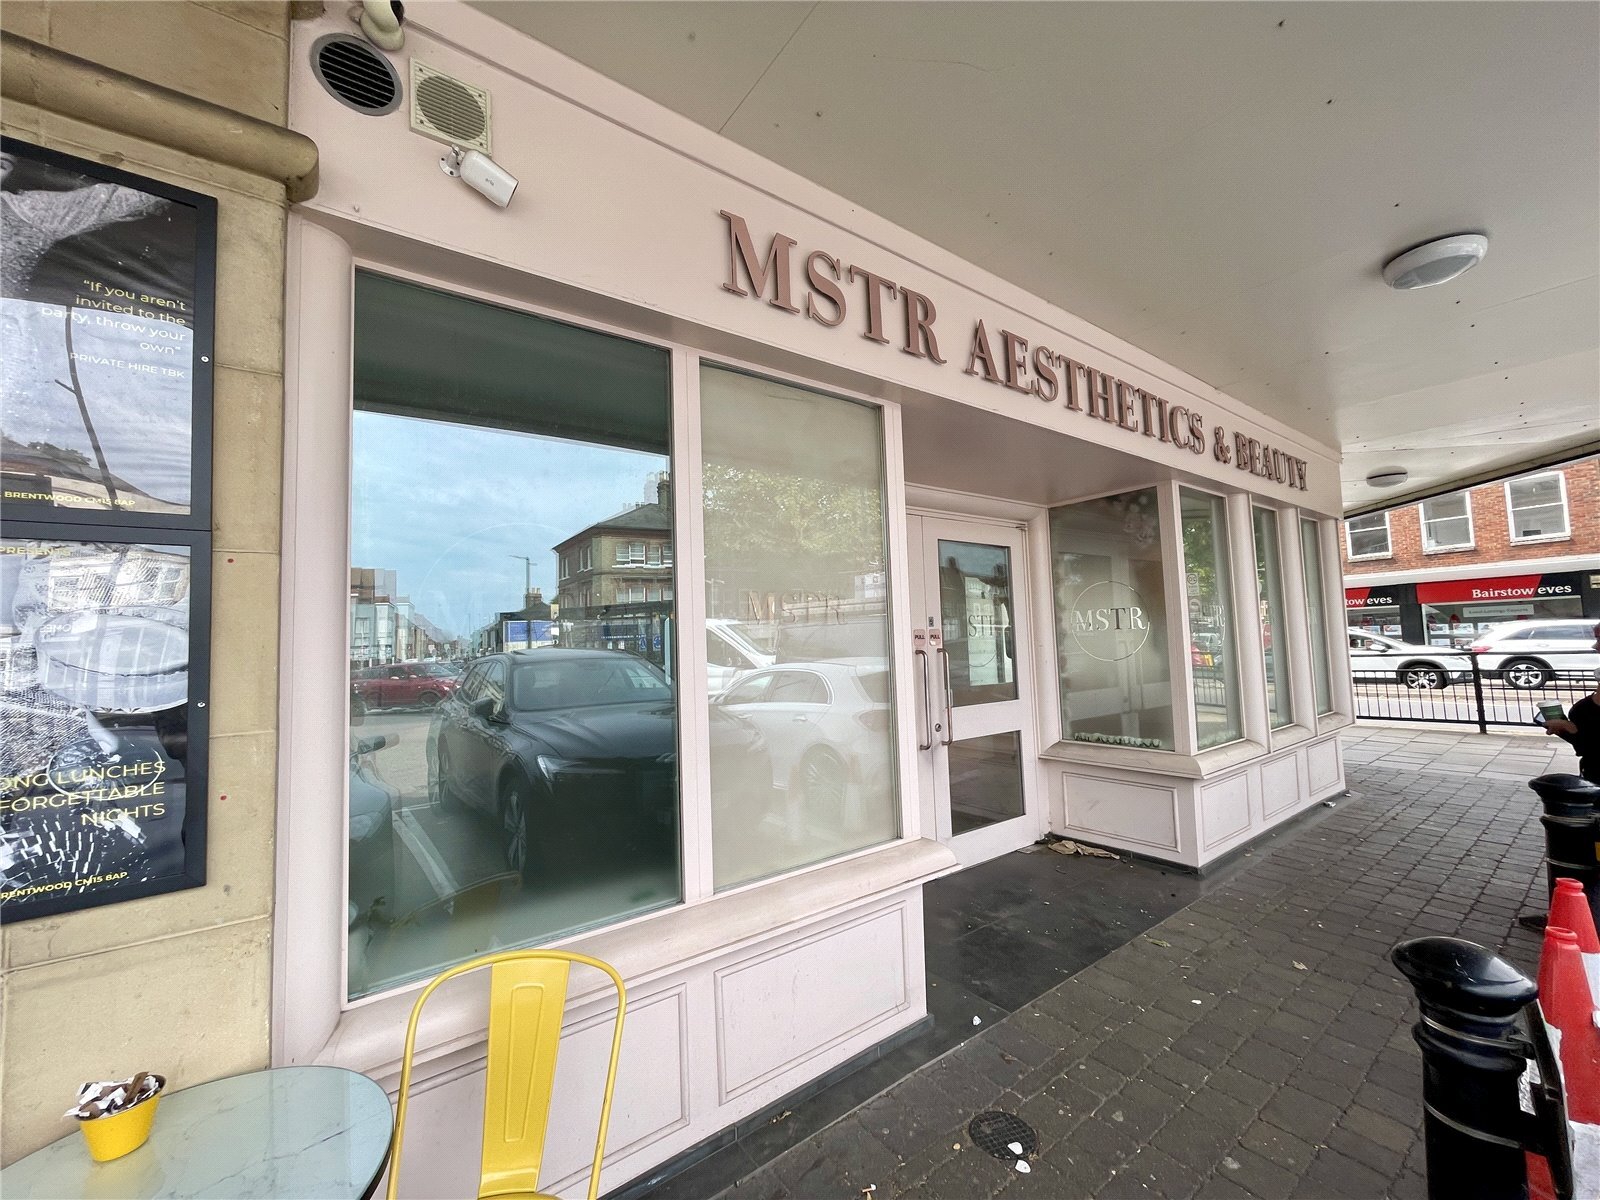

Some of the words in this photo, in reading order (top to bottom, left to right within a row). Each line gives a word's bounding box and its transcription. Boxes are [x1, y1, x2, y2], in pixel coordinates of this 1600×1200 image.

[104, 286, 136, 300] you
[76, 294, 134, 316] invited
[138, 308, 155, 320] to
[159, 312, 186, 326] the
[96, 315, 146, 334] throw
[148, 327, 187, 341] your
[720, 209, 948, 365] MSTR
[965, 318, 1206, 456] AESTHETICS
[1213, 426, 1232, 465] &
[1235, 431, 1310, 492] BEAUTY
[69, 352, 126, 369] PRIVATE
[128, 362, 158, 375] HIRE
[161, 366, 186, 379] TBK
[4, 491, 82, 503] BRENTWOOD
[1366, 595, 1393, 605] eves
[1471, 586, 1535, 599] Bairstow
[1537, 584, 1572, 595] eves
[1074, 606, 1148, 632] MSTR
[57, 761, 167, 785] LUNCHES
[81, 803, 166, 826] NIGHTS
